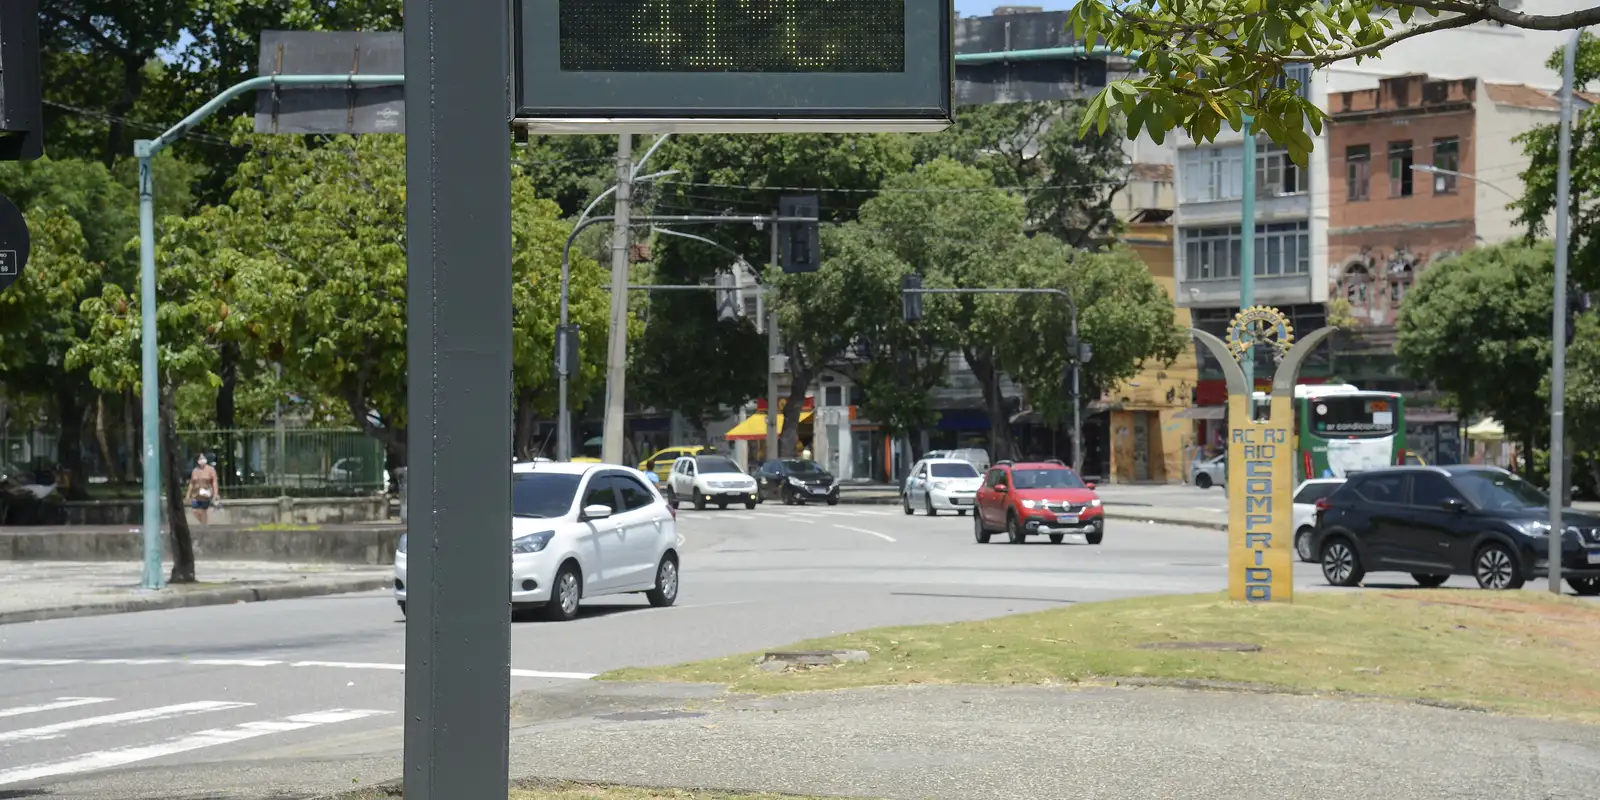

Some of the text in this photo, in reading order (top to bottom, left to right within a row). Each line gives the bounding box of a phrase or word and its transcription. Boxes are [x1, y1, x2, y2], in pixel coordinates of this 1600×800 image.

[1232, 429, 1286, 443] RC RJ
[1244, 445, 1275, 459] RIO
[1246, 460, 1272, 601] COMPRIDO
